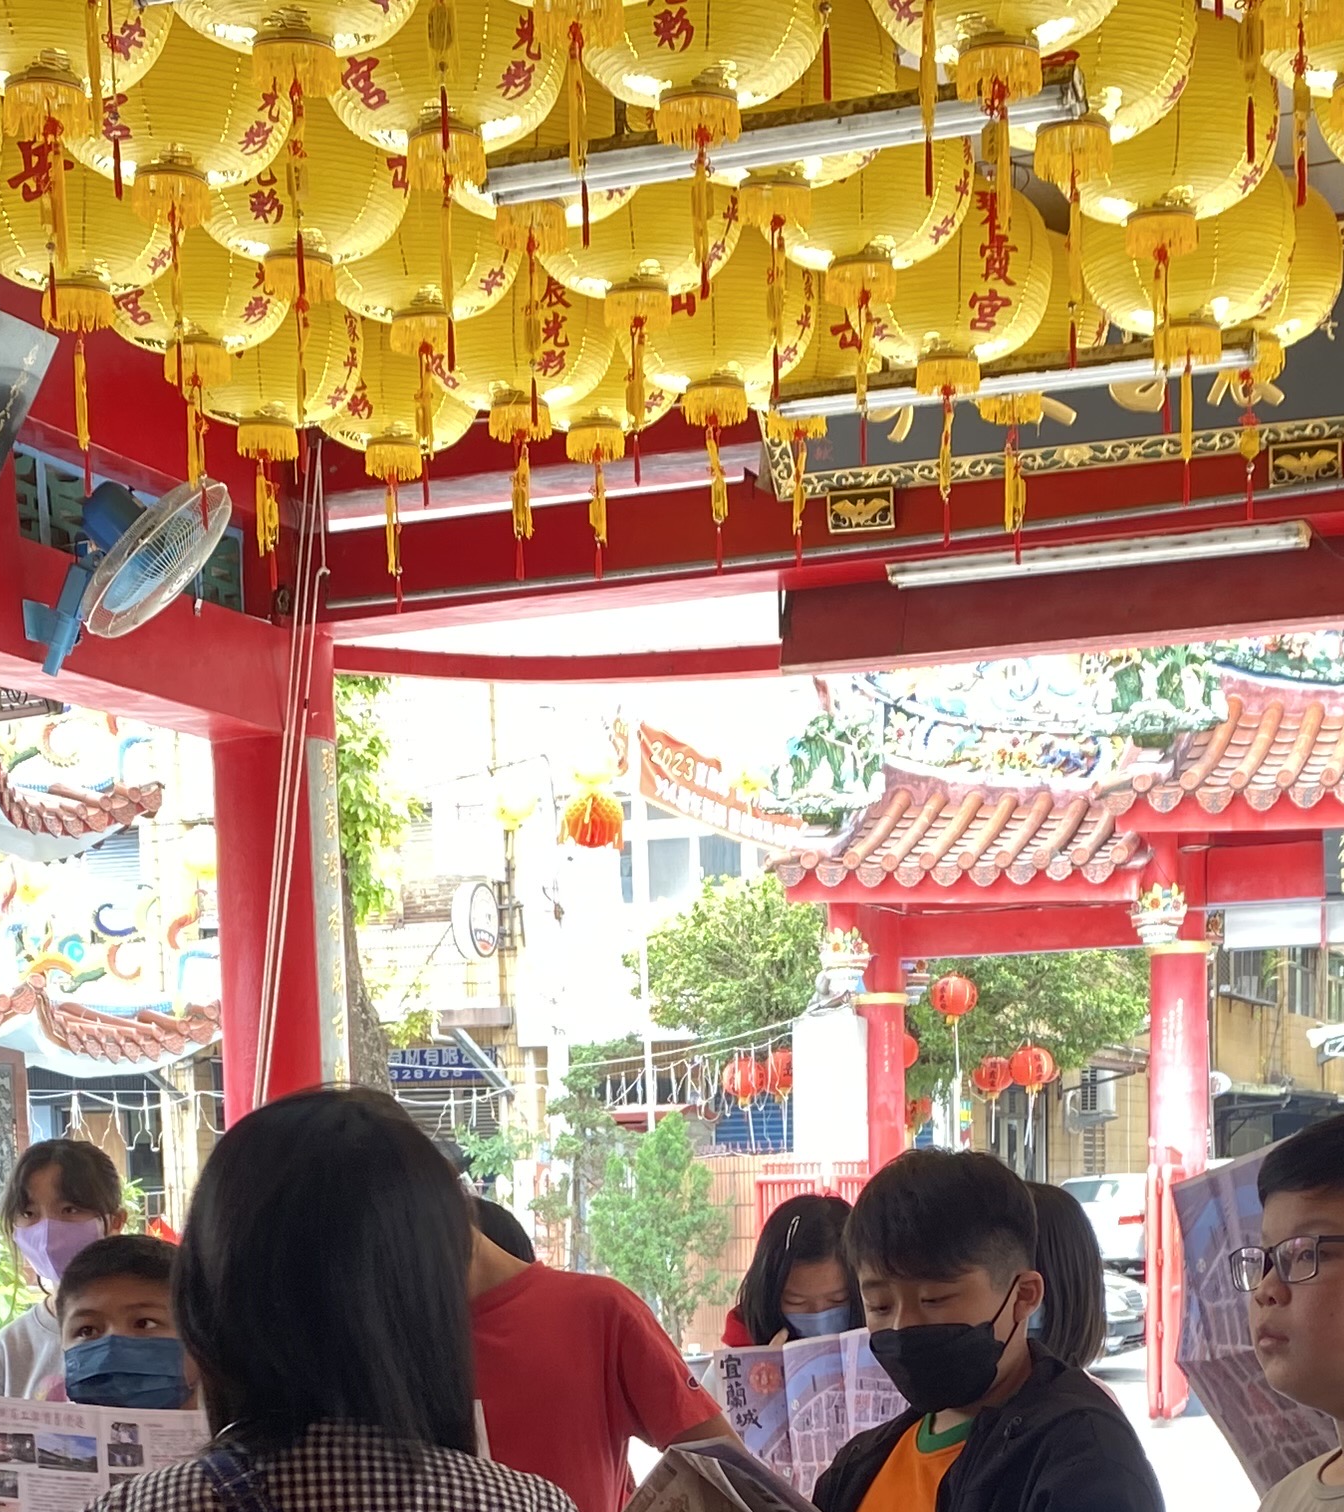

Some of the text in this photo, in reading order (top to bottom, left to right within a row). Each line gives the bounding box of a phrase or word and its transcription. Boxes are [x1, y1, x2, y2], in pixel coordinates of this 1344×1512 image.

[650, 740, 695, 783] 2023
[720, 1354, 762, 1429] 宜蘭城
